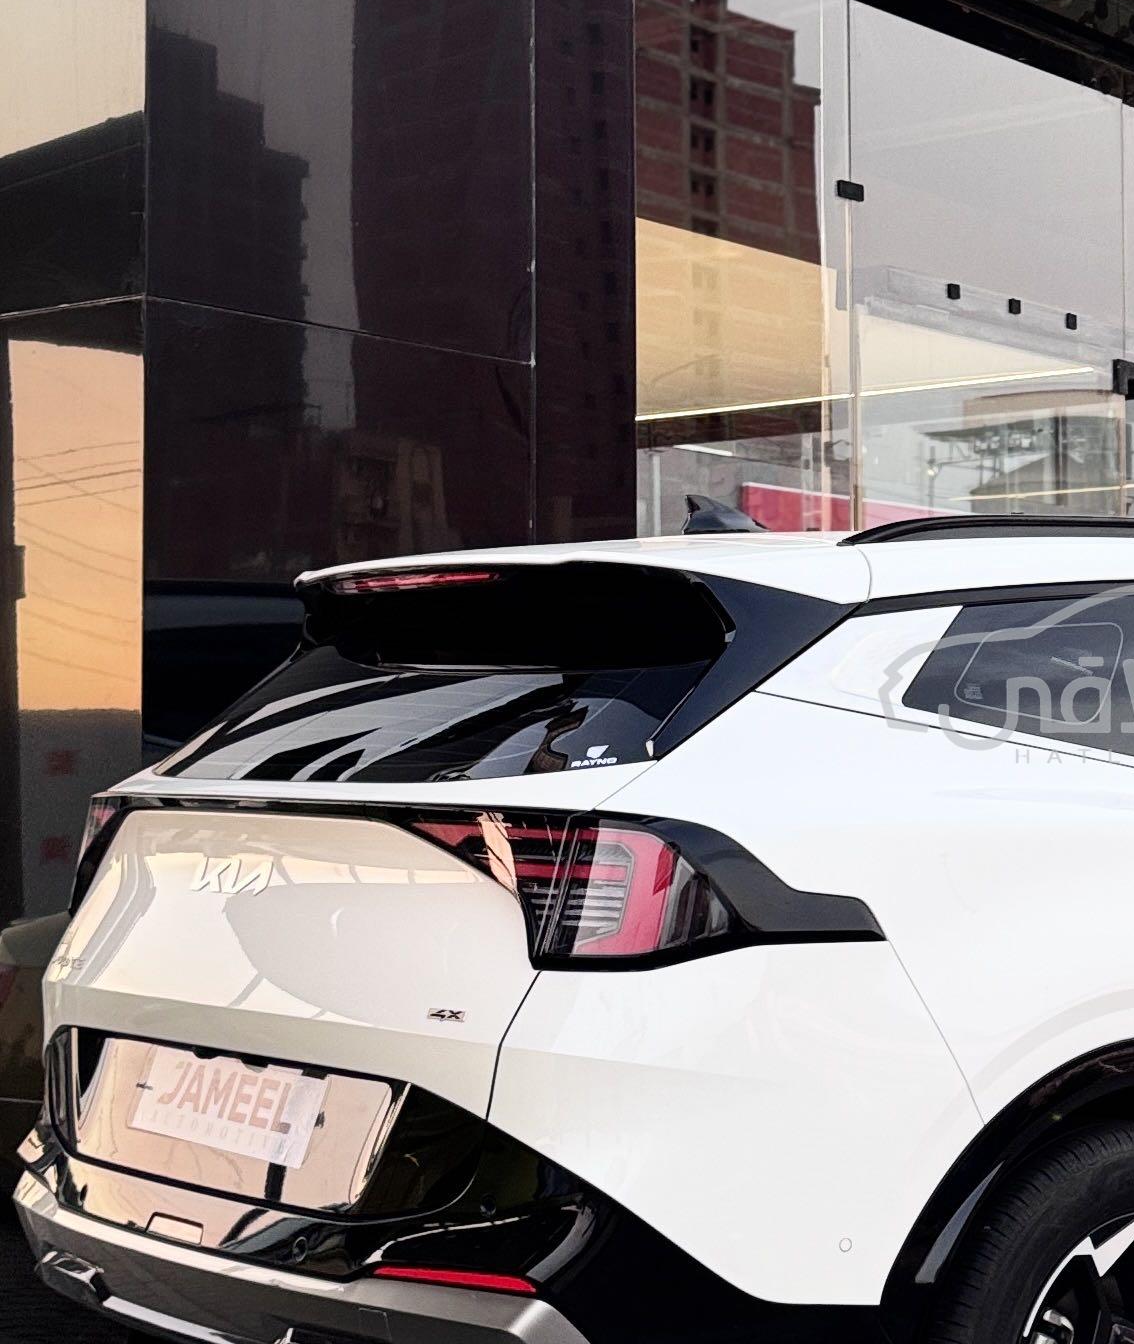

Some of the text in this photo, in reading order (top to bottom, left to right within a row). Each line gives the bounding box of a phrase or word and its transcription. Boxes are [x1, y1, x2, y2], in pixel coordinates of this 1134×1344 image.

[571, 757, 618, 768] RAYNO
[190, 855, 274, 896] KIA
[158, 1060, 292, 1134] JAMEEL
